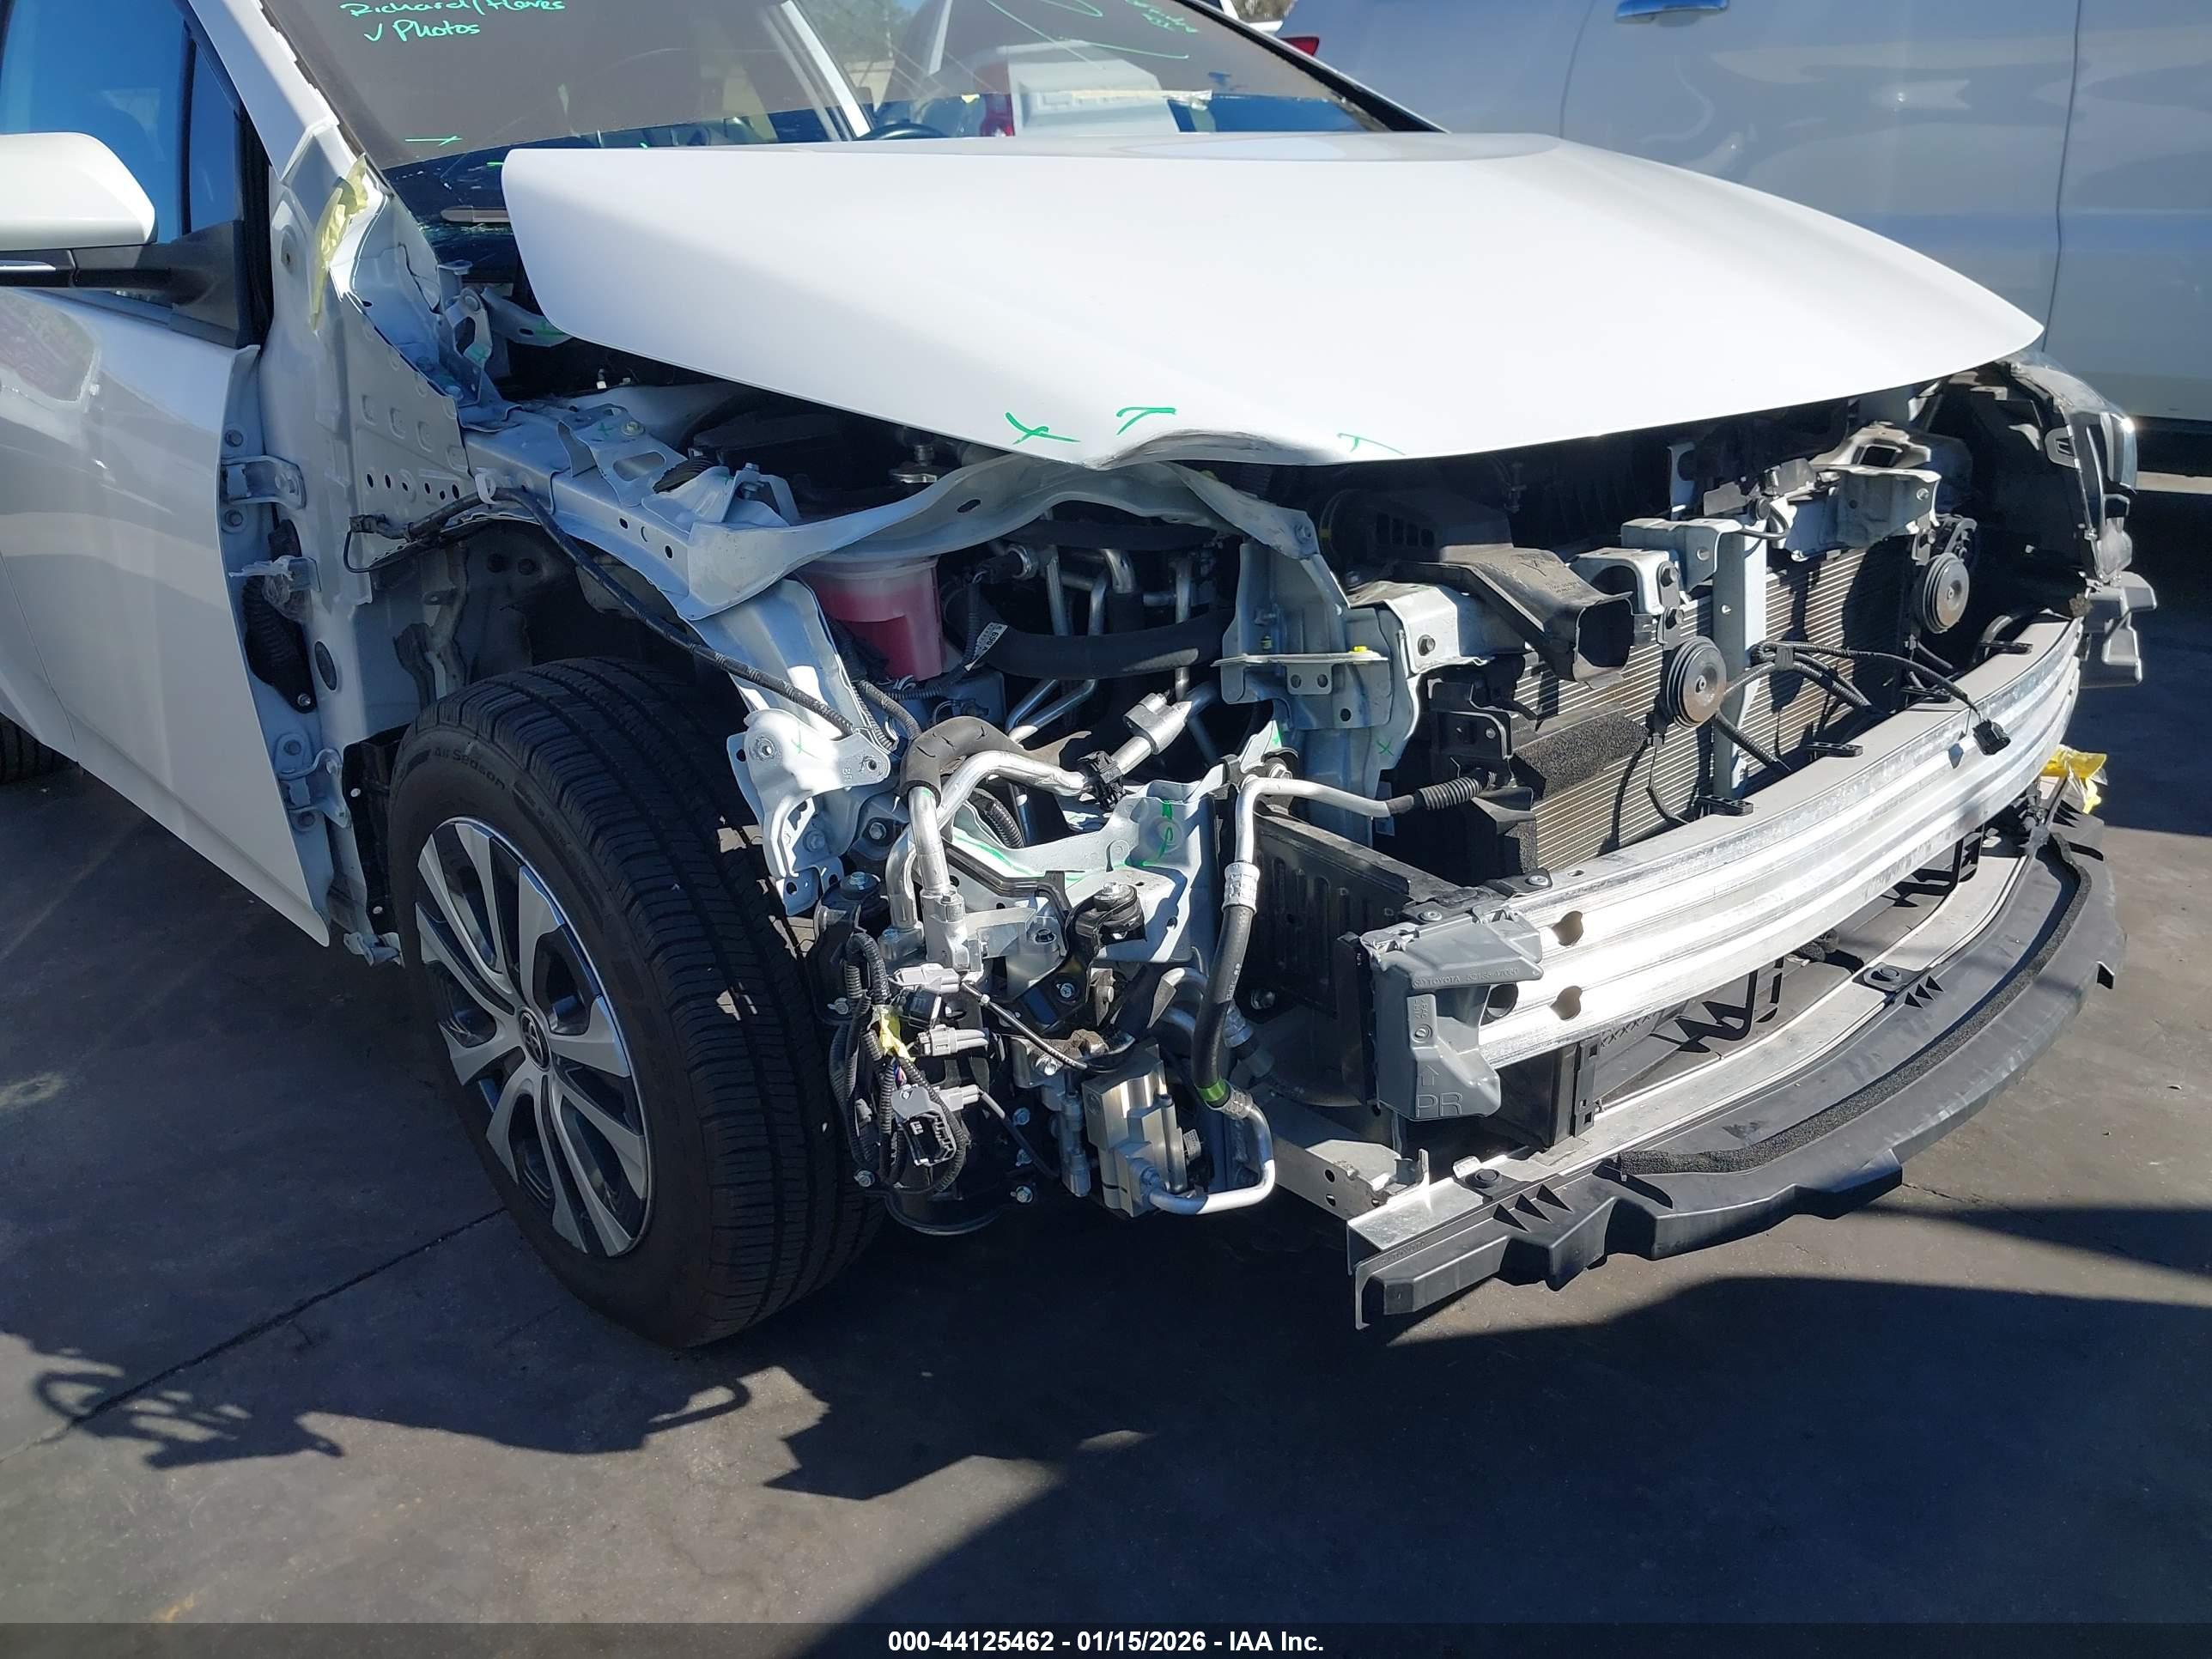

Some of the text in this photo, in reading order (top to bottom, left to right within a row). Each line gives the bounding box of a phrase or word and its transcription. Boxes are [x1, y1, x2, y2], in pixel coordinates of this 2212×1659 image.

[392, 20, 480, 41] Photos
[453, 750, 506, 791] Season
[1416, 1092, 1462, 1118] PR
